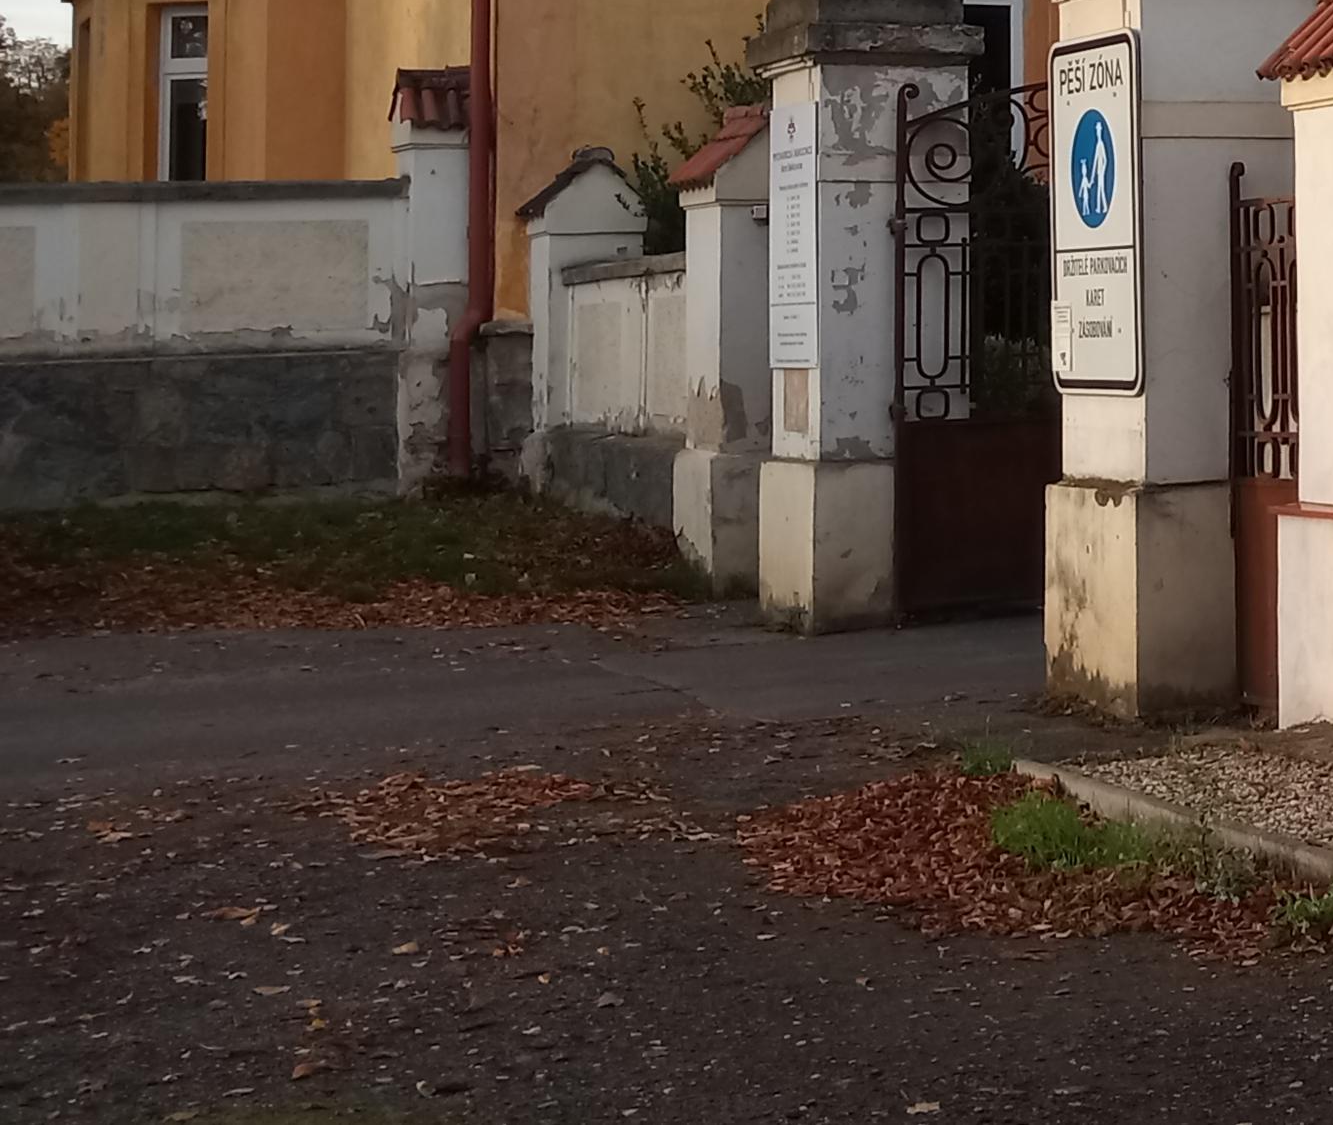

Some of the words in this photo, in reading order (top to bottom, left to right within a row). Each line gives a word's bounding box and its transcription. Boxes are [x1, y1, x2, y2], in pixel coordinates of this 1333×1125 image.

[1059, 57, 1086, 96] PĚŠÍ
[1089, 54, 1123, 90] ZÓNA
[1063, 254, 1089, 277] DRŽITELÉ
[1086, 288, 1105, 307] KARET
[1078, 316, 1113, 338] ZÁSOBOVÁNÍ
